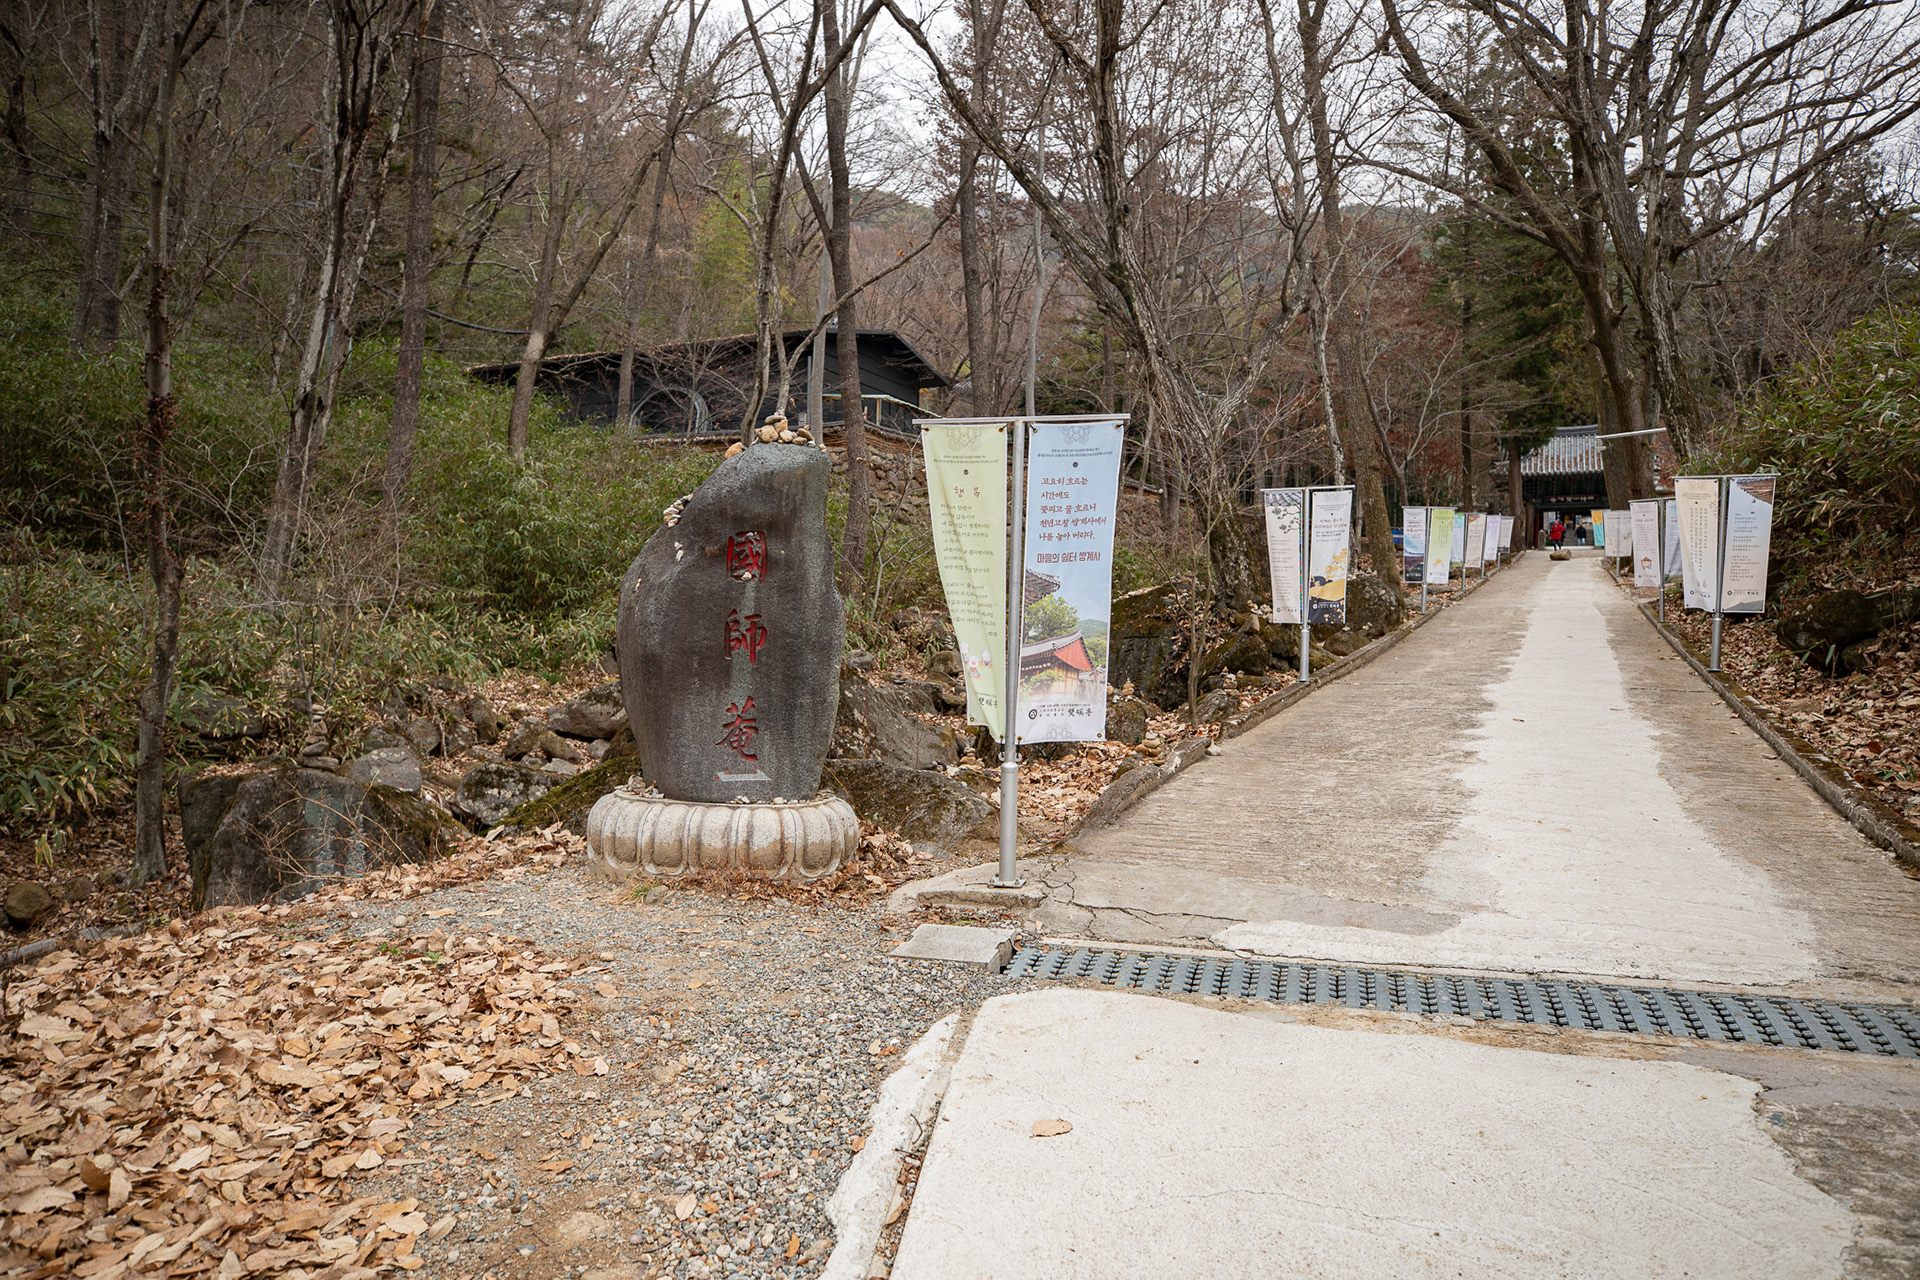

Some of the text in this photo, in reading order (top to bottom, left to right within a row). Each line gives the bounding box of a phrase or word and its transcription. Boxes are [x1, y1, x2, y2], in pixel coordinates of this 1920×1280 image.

[1041, 476, 1089, 486] 고요히 흐르는
[1041, 491, 1070, 500] 시간에도
[1040, 503, 1097, 514] 꽃피고 물 흐르니
[1040, 516, 1107, 528] 천년고찰 쌍계사에서
[1039, 530, 1095, 541] 나를 놓아 버리다.
[1037, 551, 1101, 563] 마음의 쉼터 쌍계사
[715, 530, 768, 762] 國師菴
